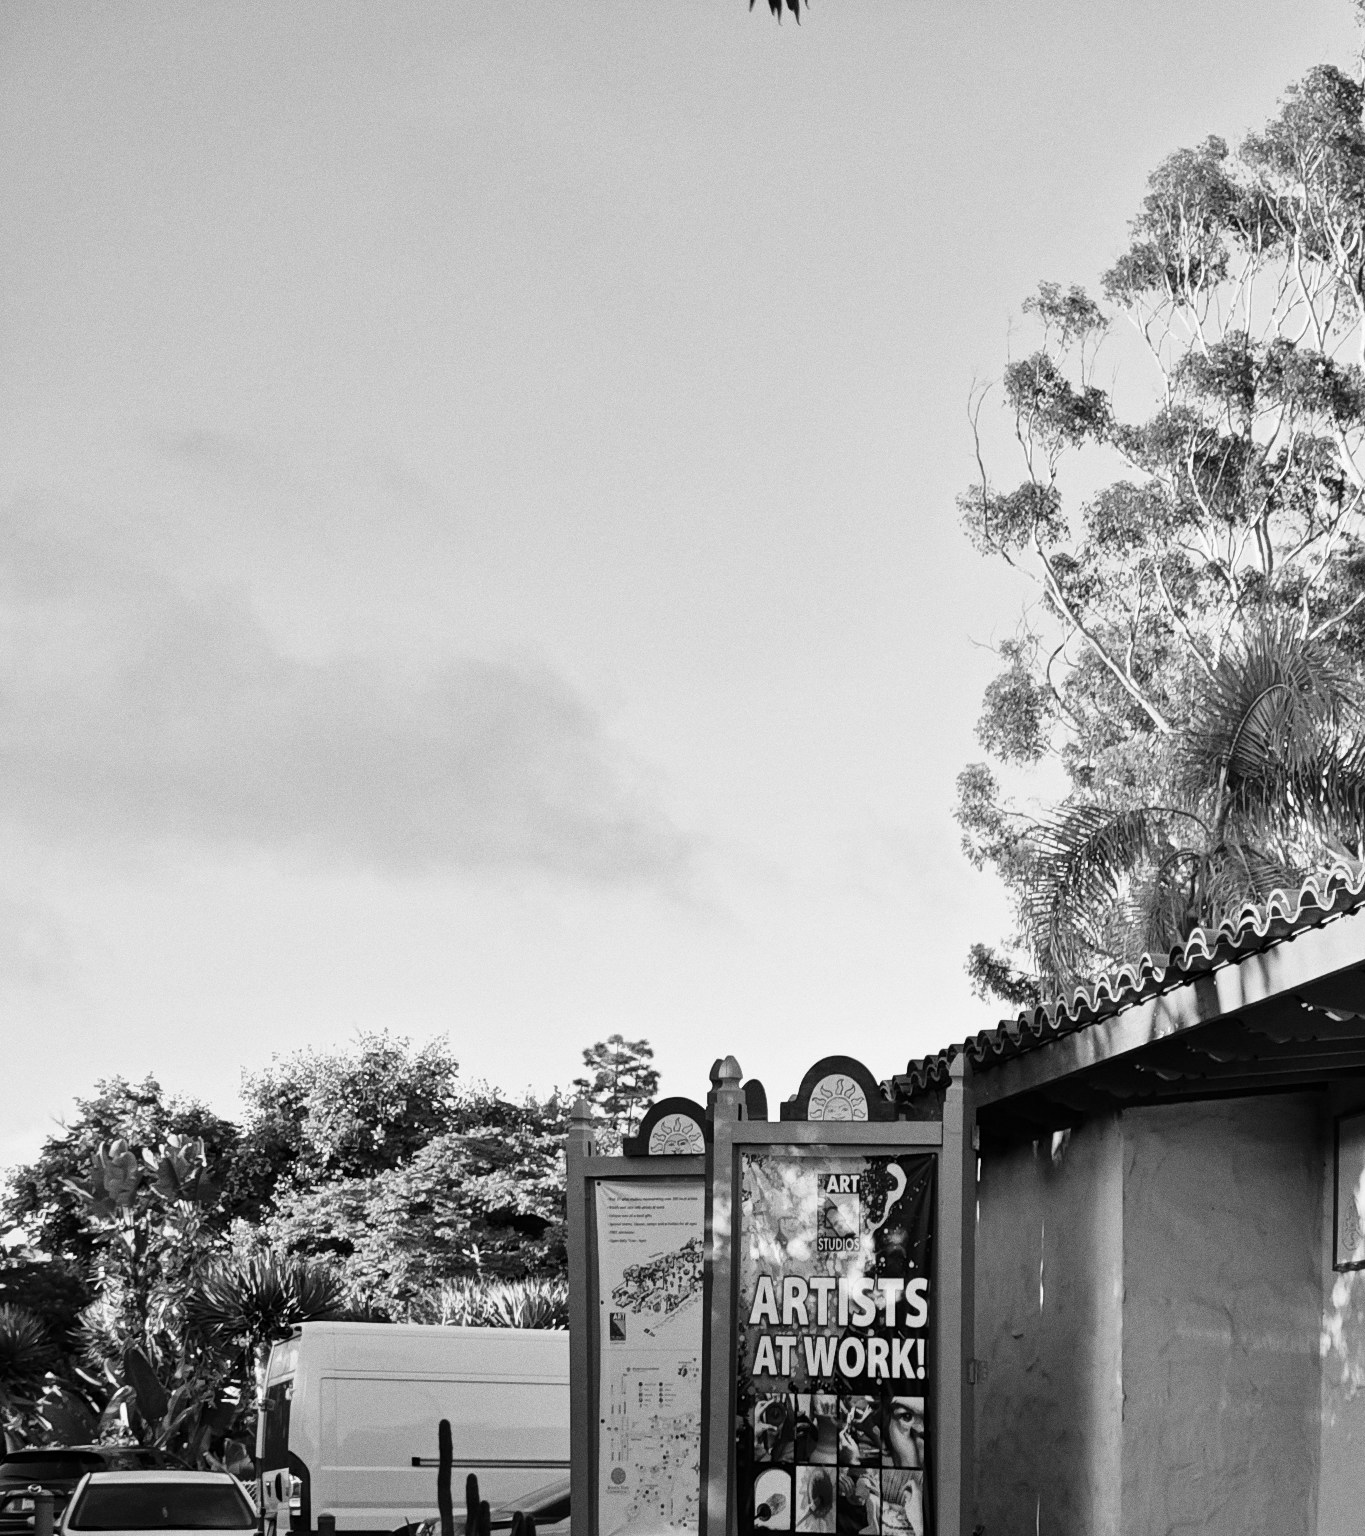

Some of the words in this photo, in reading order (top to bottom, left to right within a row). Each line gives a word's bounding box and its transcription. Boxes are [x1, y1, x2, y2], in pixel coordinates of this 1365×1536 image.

[826, 1174, 861, 1193] ART
[818, 1237, 860, 1251] STUDIOS
[749, 1275, 928, 1328] ARTISTS
[752, 1335, 797, 1376] AT
[803, 1336, 926, 1380] WORK!
